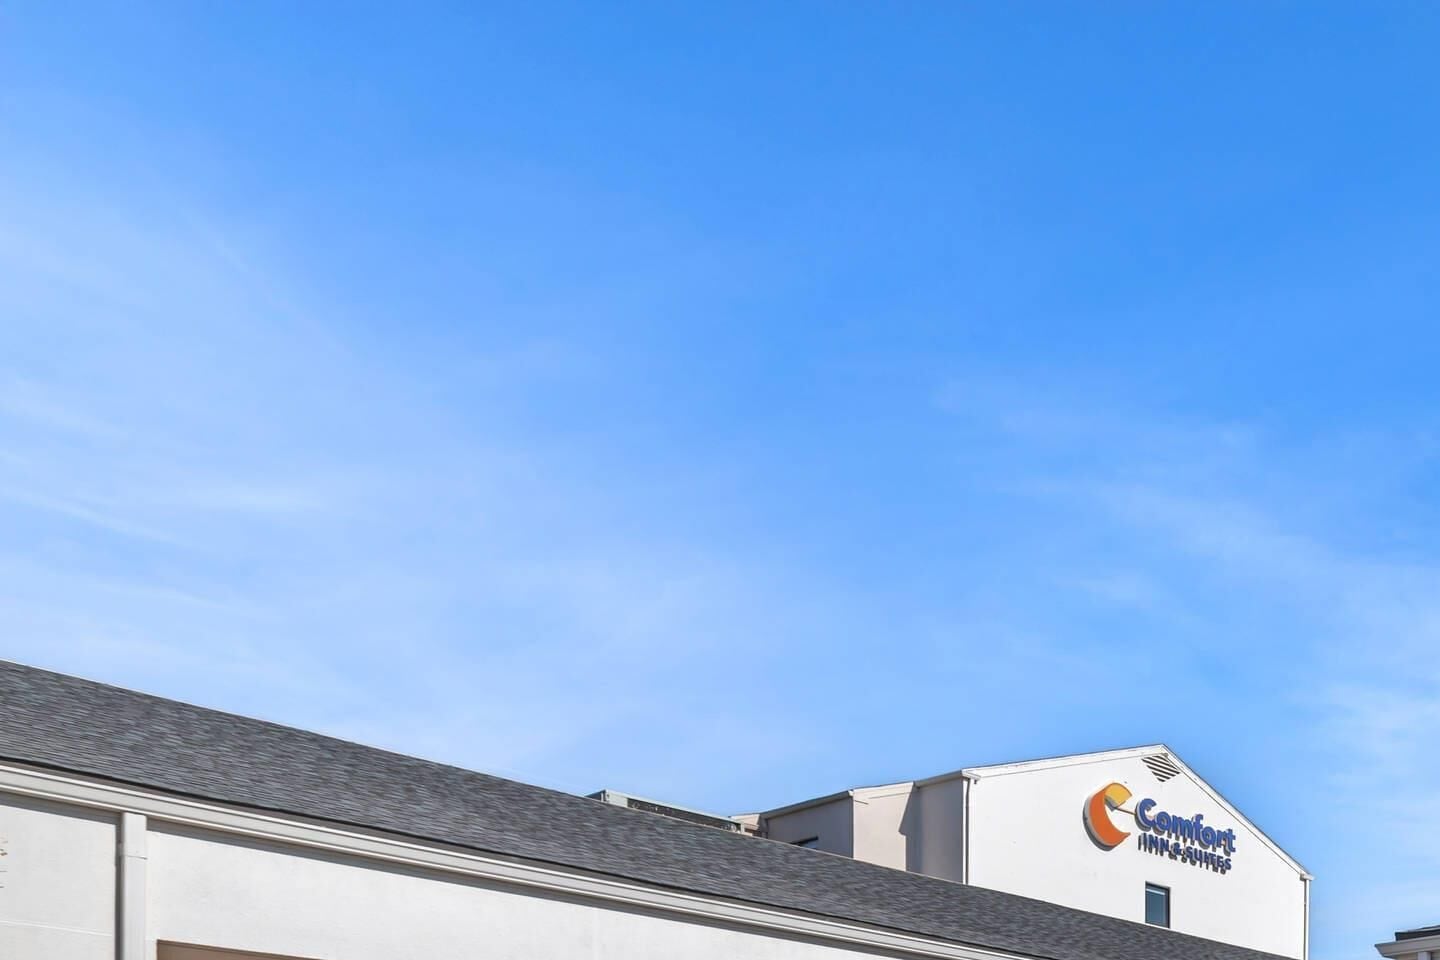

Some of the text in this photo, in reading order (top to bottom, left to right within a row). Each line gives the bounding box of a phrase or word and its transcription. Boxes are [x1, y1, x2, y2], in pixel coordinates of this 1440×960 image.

[1136, 798, 1236, 853] Comfort
[1140, 832, 1232, 871] INN & SUITES
